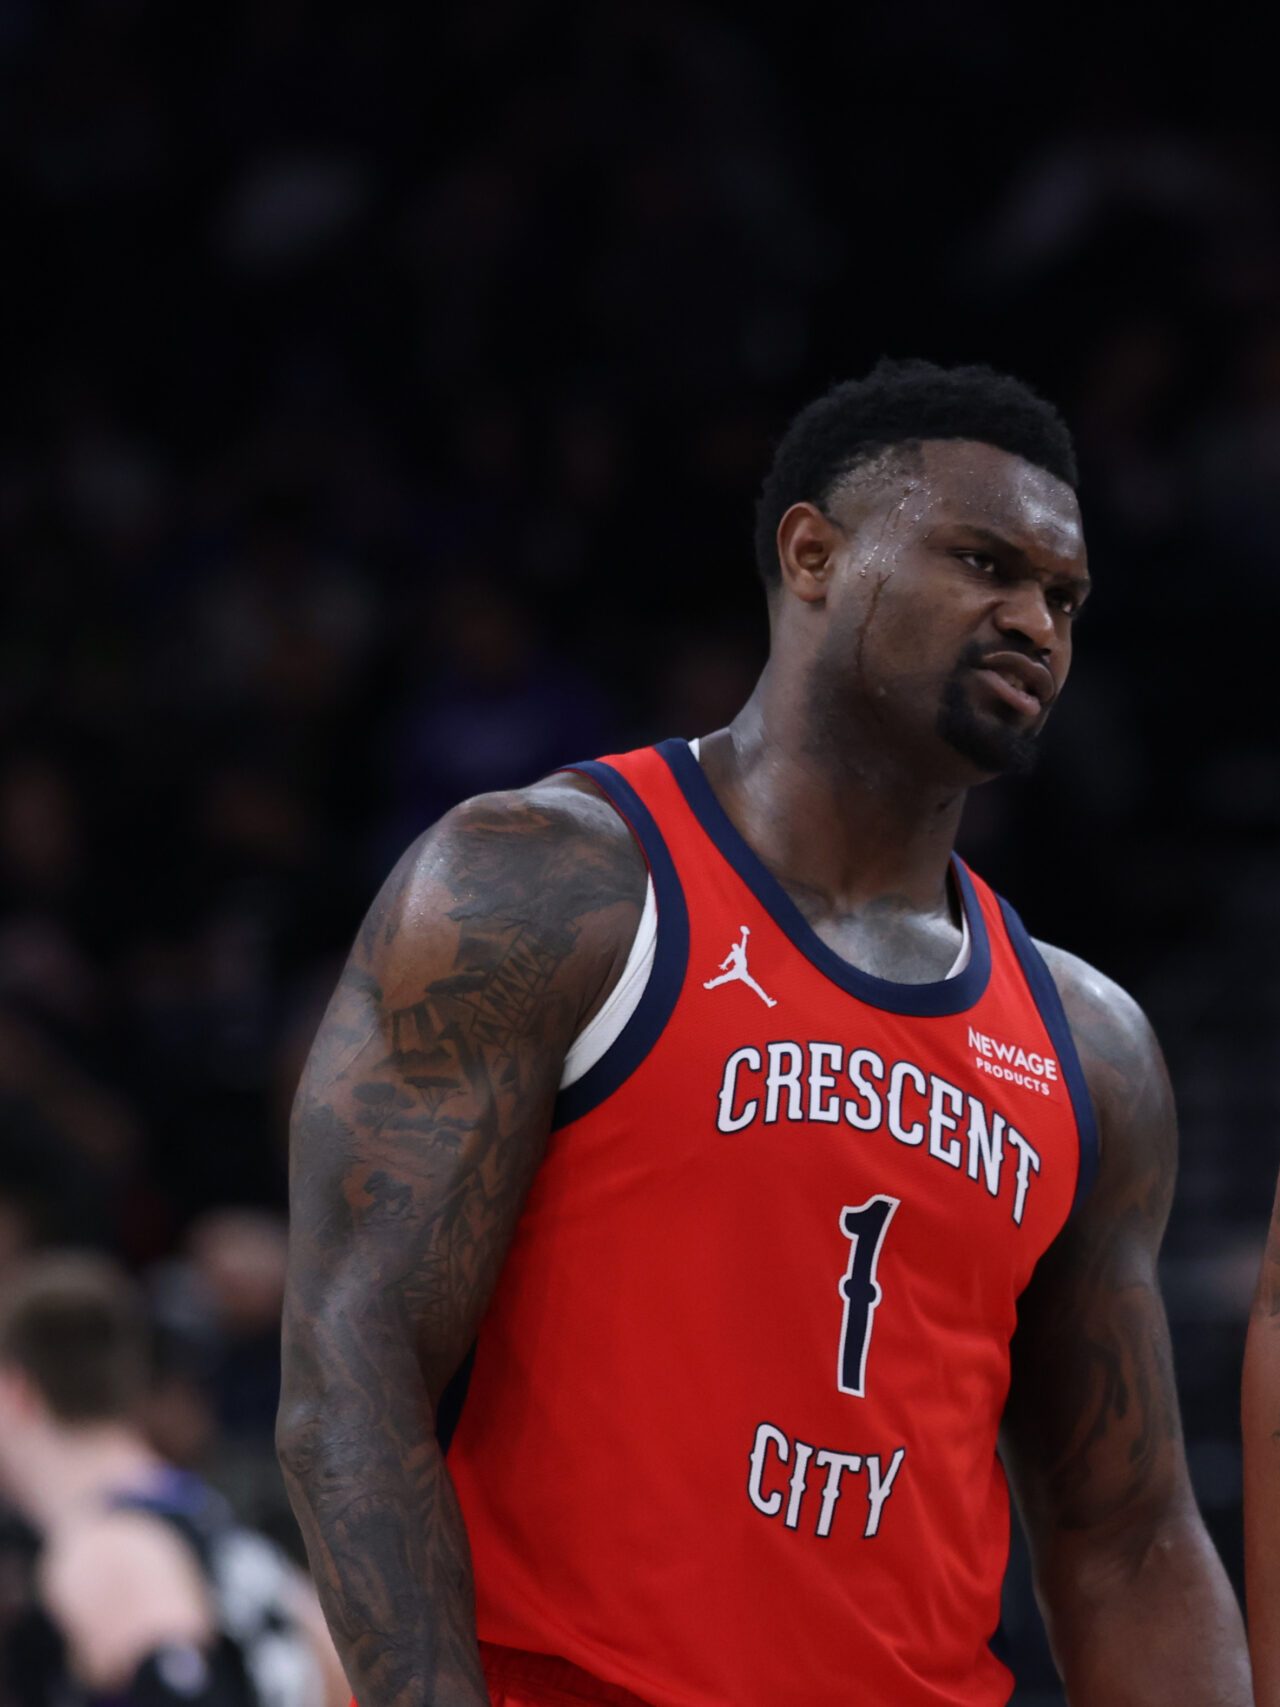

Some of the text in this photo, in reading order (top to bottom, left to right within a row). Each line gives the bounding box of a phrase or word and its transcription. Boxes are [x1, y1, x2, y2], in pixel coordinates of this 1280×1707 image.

[967, 1026, 1058, 1081] NEWAGE
[976, 1057, 1050, 1097] PRODUCTS
[717, 1040, 1040, 1228] CRESCENT
[838, 1194, 900, 1398] 1
[748, 1421, 905, 1539] CITY
